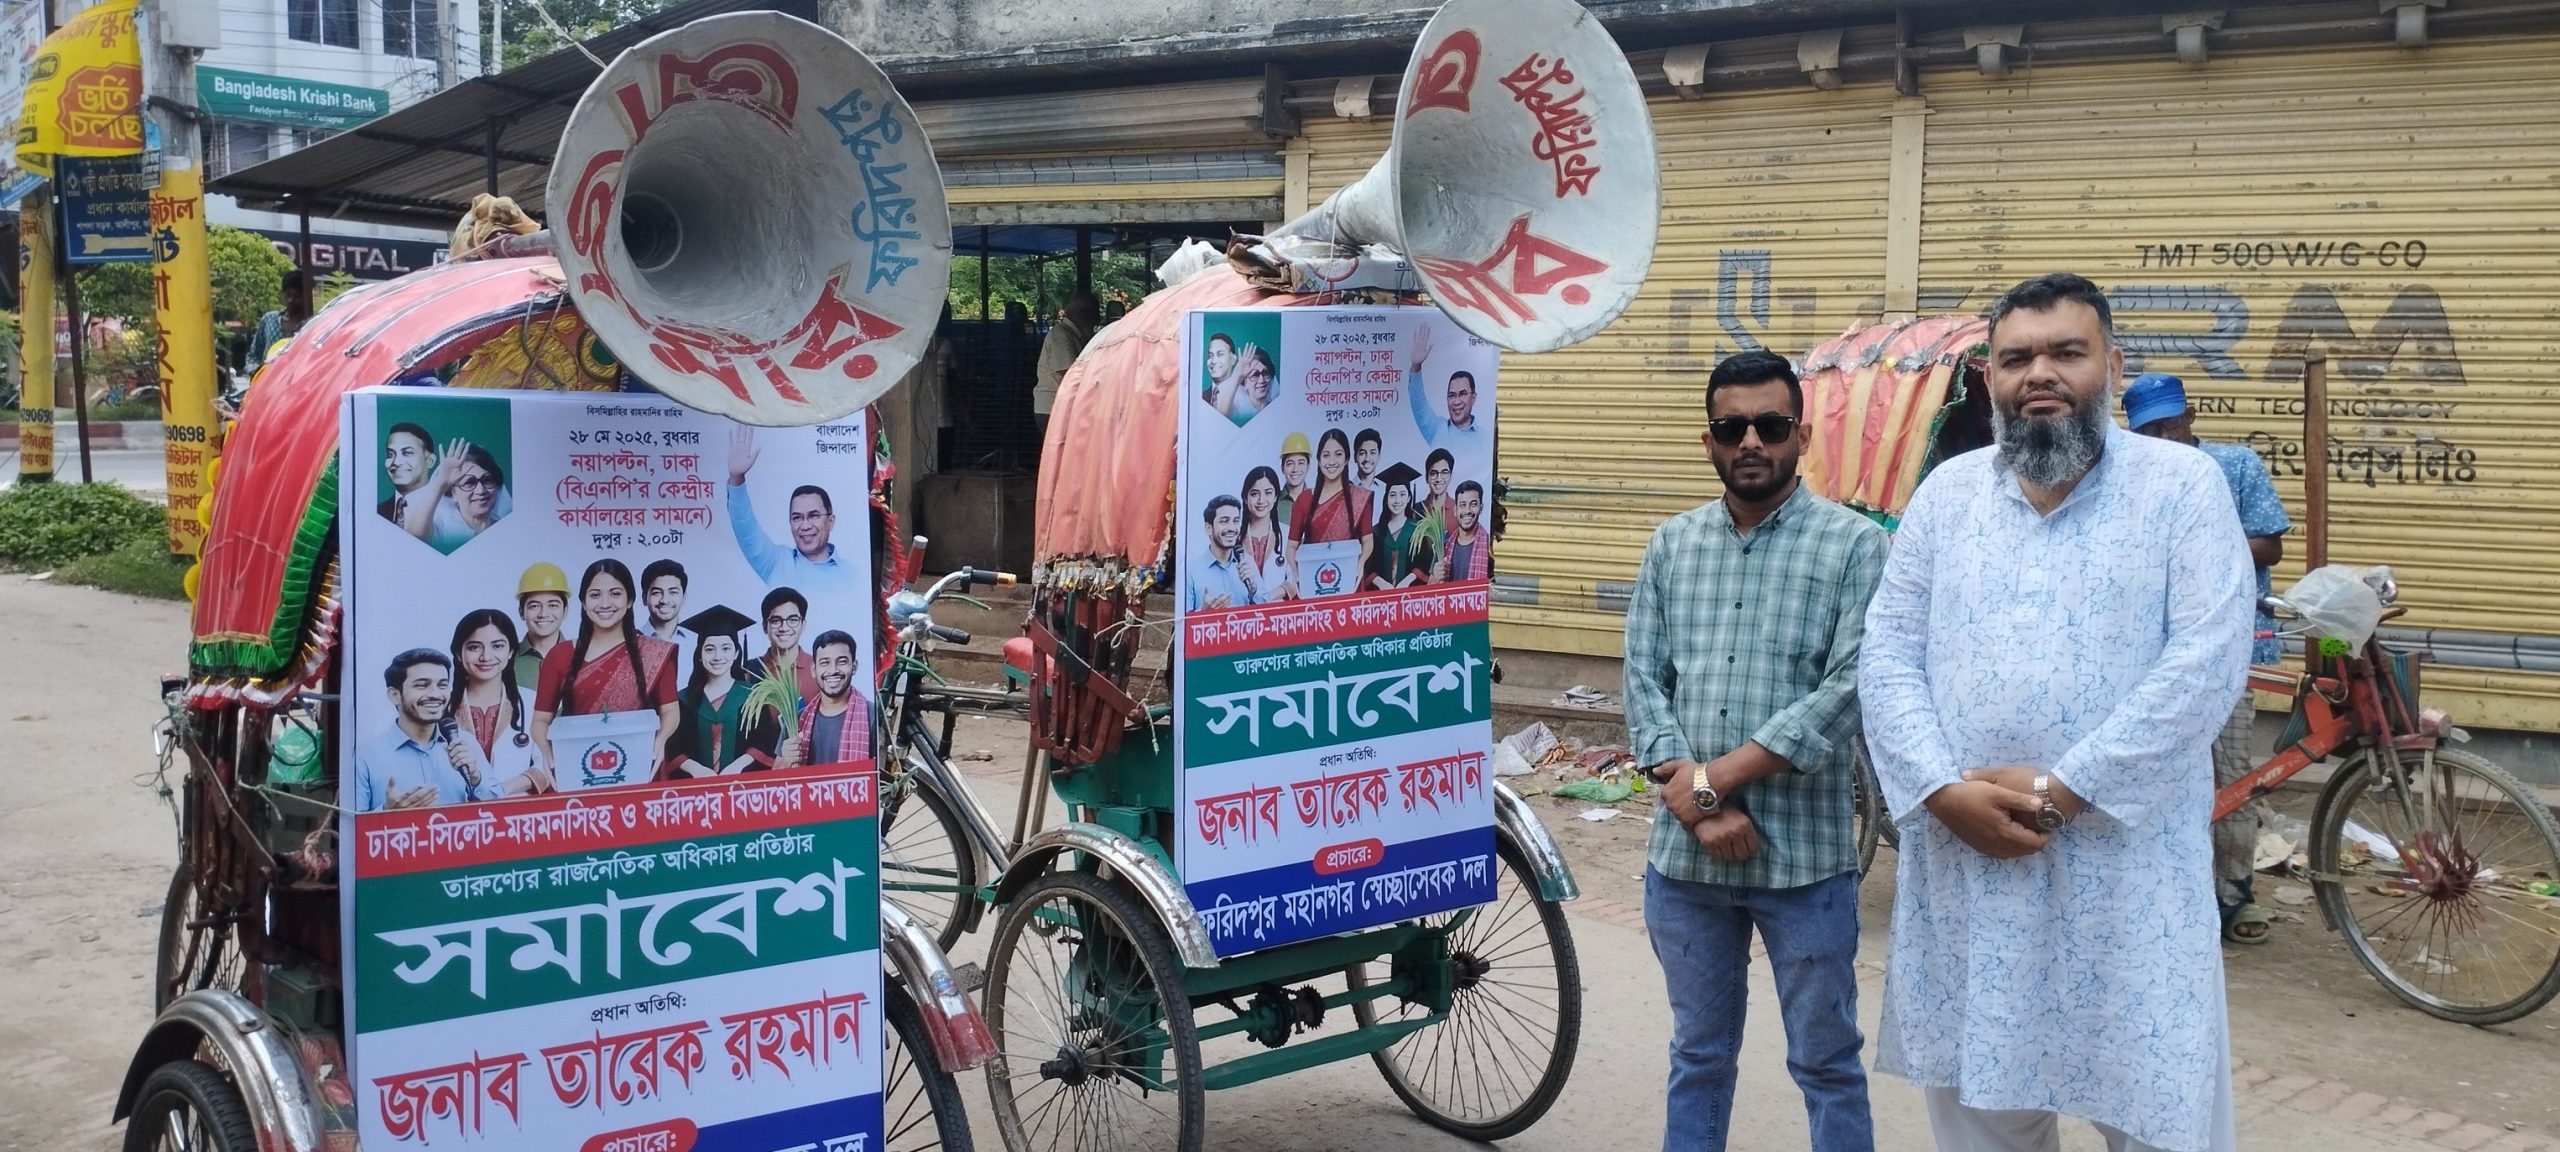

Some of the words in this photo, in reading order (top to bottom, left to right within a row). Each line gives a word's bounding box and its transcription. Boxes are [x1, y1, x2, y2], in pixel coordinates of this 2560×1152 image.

[78, 75, 130, 113] ভর্তি
[214, 76, 297, 101] Bangladesh
[300, 88, 340, 107] Krishi
[343, 93, 376, 112] Bank
[69, 111, 142, 142] চলছে
[1499, 53, 1601, 198] ফরিদপুর
[818, 88, 922, 294] ফরিদপুর
[87, 202, 113, 216] প্রধান
[115, 198, 149, 216] কার্যাল
[2135, 243, 2204, 268] TMT
[1315, 333, 1327, 345] ২৮
[1331, 334, 1340, 344] মে
[1343, 333, 1369, 346] ২০২৫,
[1372, 332, 1396, 345] বুধবার
[1315, 349, 1366, 367] নয়াপল্টন,
[1370, 350, 1394, 364] ঢাকা
[1366, 365, 1402, 385] কেন্দ্রীয়
[1305, 387, 1358, 406] কার্যালয়ের
[1363, 388, 1400, 407] সামনে)
[2256, 398, 2457, 420] TECNOLOGY
[587, 405, 627, 416] বিসমিল্লাহির
[630, 406, 661, 417] রাহমানির
[664, 407, 683, 418] রাহিম
[1325, 410, 1343, 423] দুপুর
[1352, 407, 1381, 420] ২.০০টা
[165, 424, 206, 443] 90698
[569, 430, 589, 444] ২৮
[595, 430, 611, 444] মে
[615, 431, 658, 446] ২০২৫,
[661, 431, 700, 447] বুধবার
[816, 424, 860, 439] বাংলাদেশ
[816, 440, 857, 457] জিন্দাবাদ
[569, 448, 655, 476] নয়াপল্টন,
[661, 453, 700, 472] ঢাকা
[658, 475, 716, 501] কেন্দ্রীয়
[557, 501, 647, 528] কার্যালয়ের
[652, 504, 713, 529] সামনে)
[592, 532, 622, 550] দুপুর
[638, 528, 684, 546] ২.০০টা
[1336, 610, 1347, 628] ও
[1351, 598, 1398, 628] ফরিদপুর
[1400, 593, 1446, 621] বিভাগের
[1448, 590, 1488, 614] সমন্বয়ে
[1233, 652, 1290, 676] তারুণ্যের
[1295, 641, 1357, 668] রাজনৈতিক
[1361, 637, 1406, 658] অধিকার
[1409, 628, 1453, 652] প্রতিষ্ঠার
[1196, 650, 1484, 748] সমাবেশ
[1319, 751, 1343, 768] প্রধান
[620, 803, 637, 829] ও
[643, 788, 724, 830] ফরিদপুর
[727, 780, 803, 819] বিভাগের
[807, 775, 871, 809] সমন্বয়ে
[1195, 781, 1284, 850] জনাব
[1291, 770, 1390, 831] তারেক
[1397, 747, 1487, 814] রহমান
[441, 867, 542, 900] তারুণ্যের
[548, 850, 655, 887] রাজনৈতিক
[662, 842, 739, 871] অধিকার
[743, 828, 815, 860] প্রতিষ্ঠার
[1326, 846, 1373, 870] প্রচারে:
[1199, 893, 1278, 941] ফরিদপুর
[1282, 878, 1356, 928] মহানগর
[1362, 858, 1457, 911] স্বেচ্ছাসেবক
[1461, 852, 1489, 890] দল
[374, 857, 866, 1000] সমাবেশ
[590, 1003, 629, 1024] প্রধান
[372, 1049, 531, 1142] জনাব
[541, 1026, 711, 1113] তারেক
[719, 988, 870, 1084] রহমান
